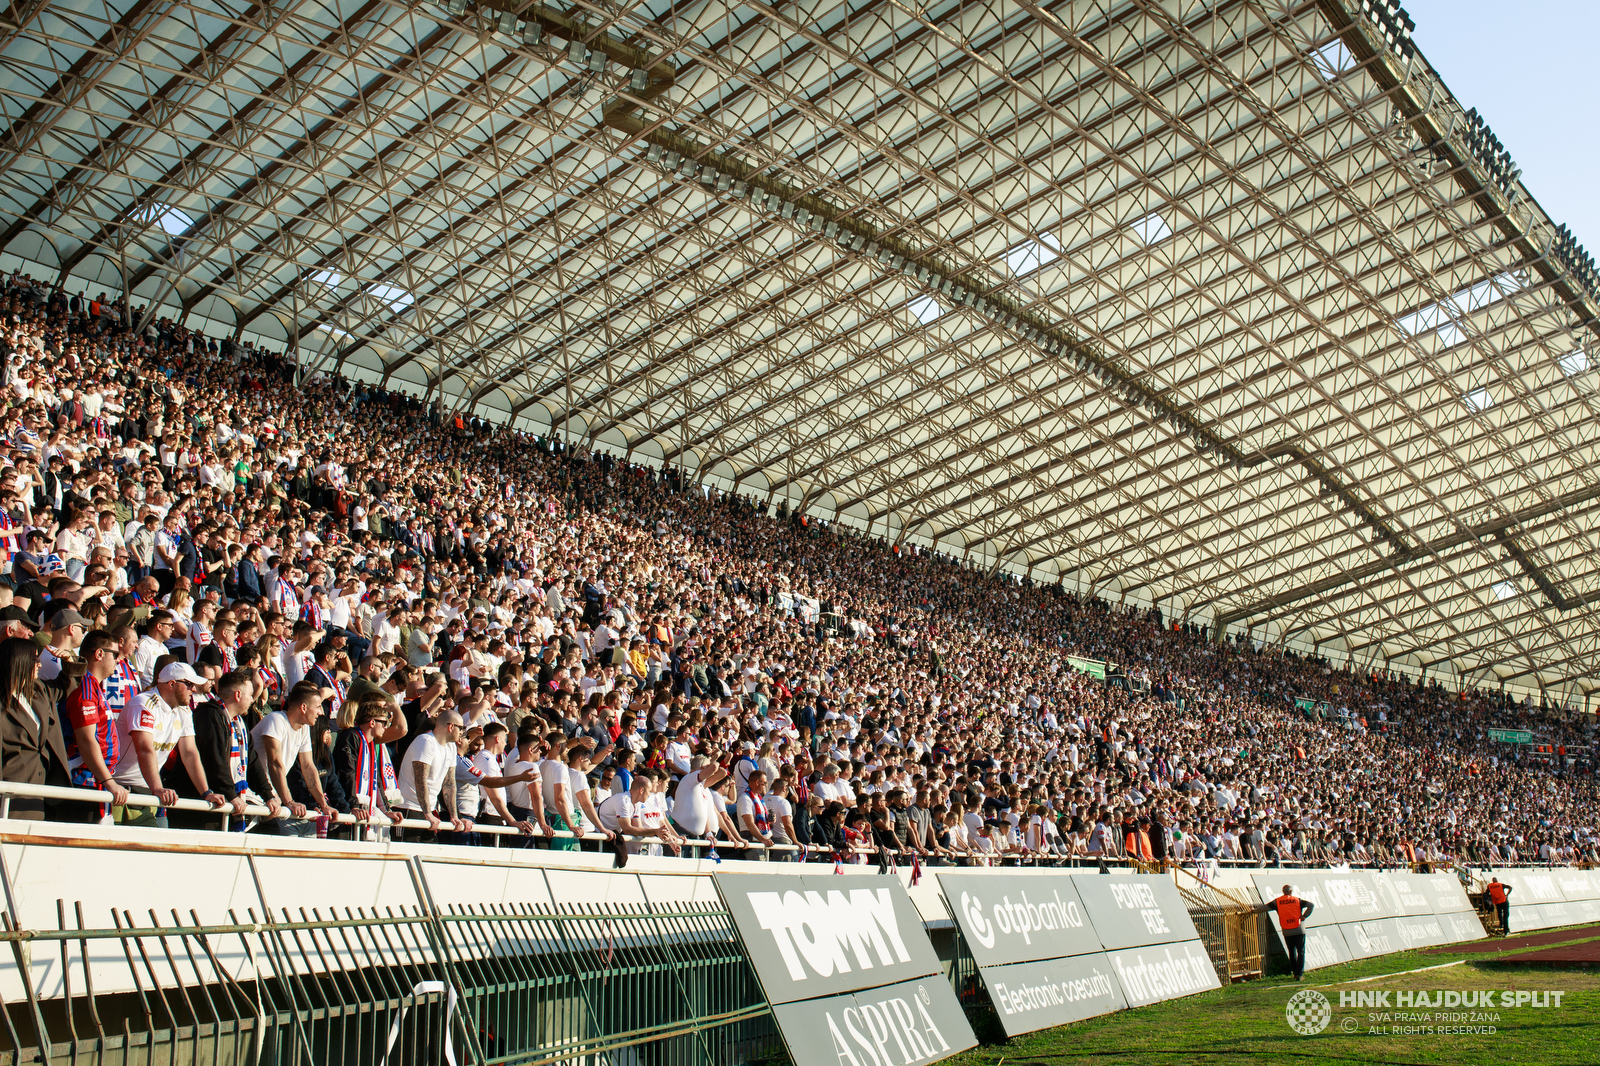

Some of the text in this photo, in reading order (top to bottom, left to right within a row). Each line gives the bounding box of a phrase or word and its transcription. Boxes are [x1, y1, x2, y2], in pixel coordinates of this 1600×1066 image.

[1109, 883, 1159, 909] POWER
[747, 888, 911, 981] TOMMY
[1140, 909, 1171, 934] ADE
[1369, 935, 1392, 953] SPLIT
[1115, 946, 1212, 1002] fortesolar.hr
[994, 976, 1064, 1015] Electronic
